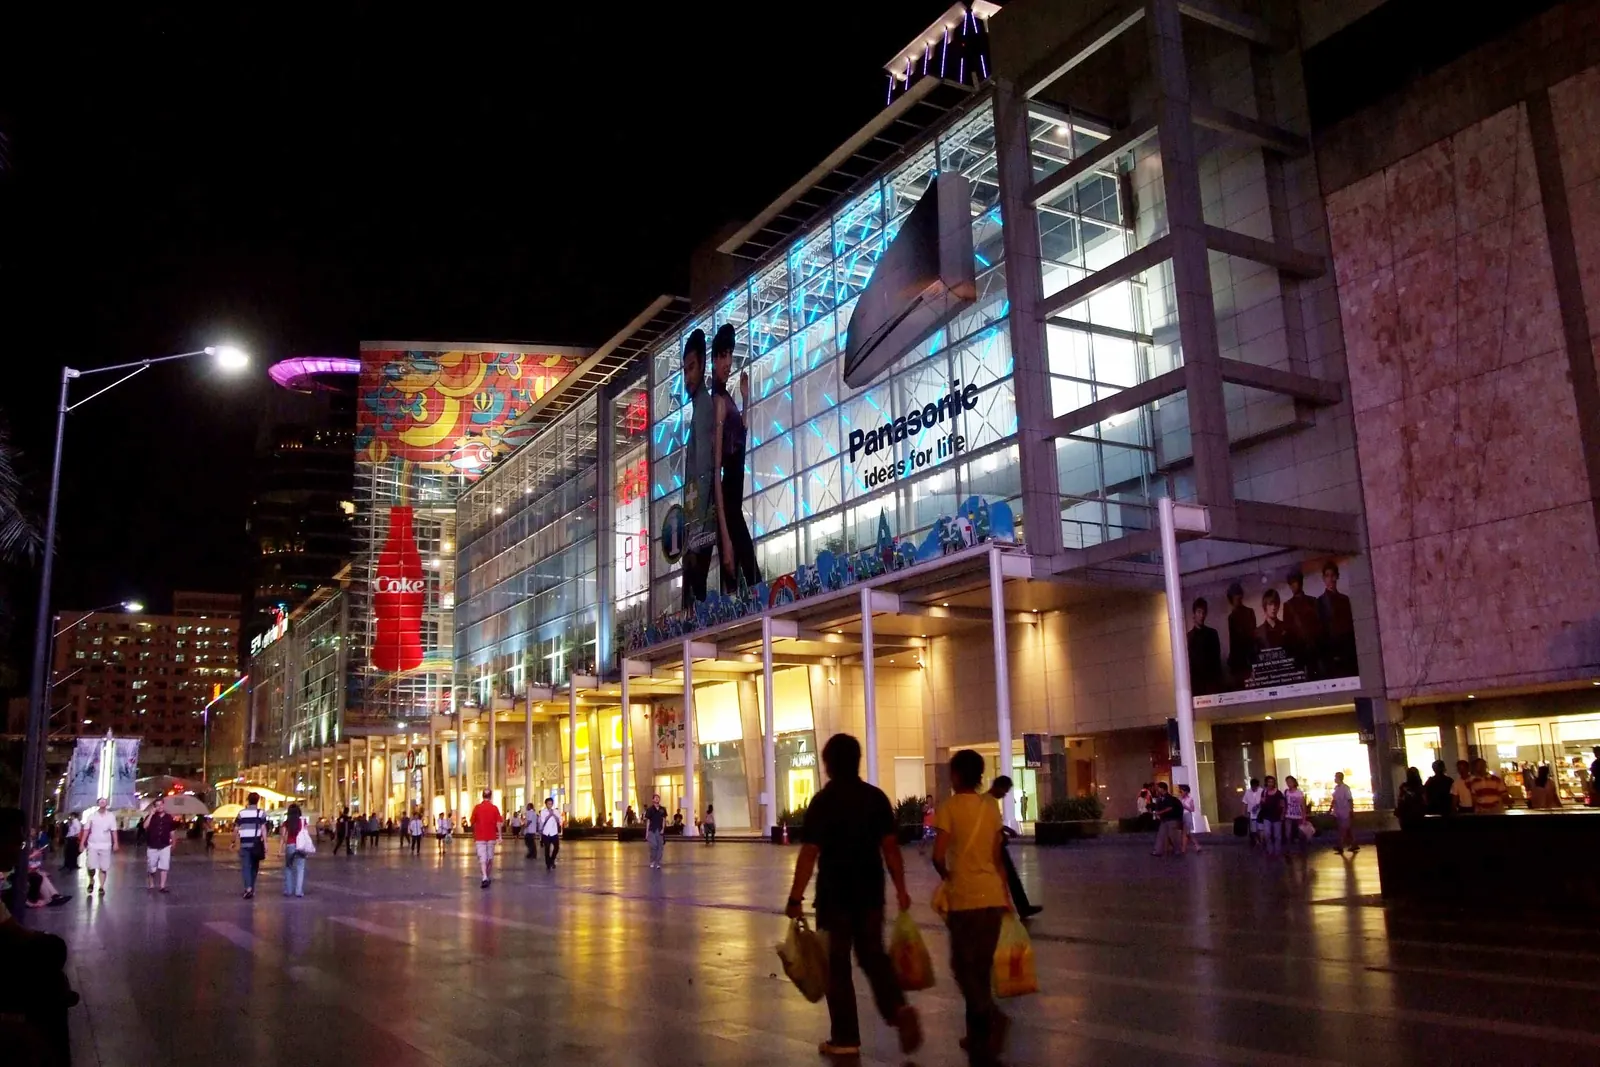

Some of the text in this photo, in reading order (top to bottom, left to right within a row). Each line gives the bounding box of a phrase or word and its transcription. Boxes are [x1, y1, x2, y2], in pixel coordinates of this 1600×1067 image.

[849, 379, 979, 463] Panasonic
[864, 432, 966, 489] ideas for life
[374, 576, 425, 593] Coke
